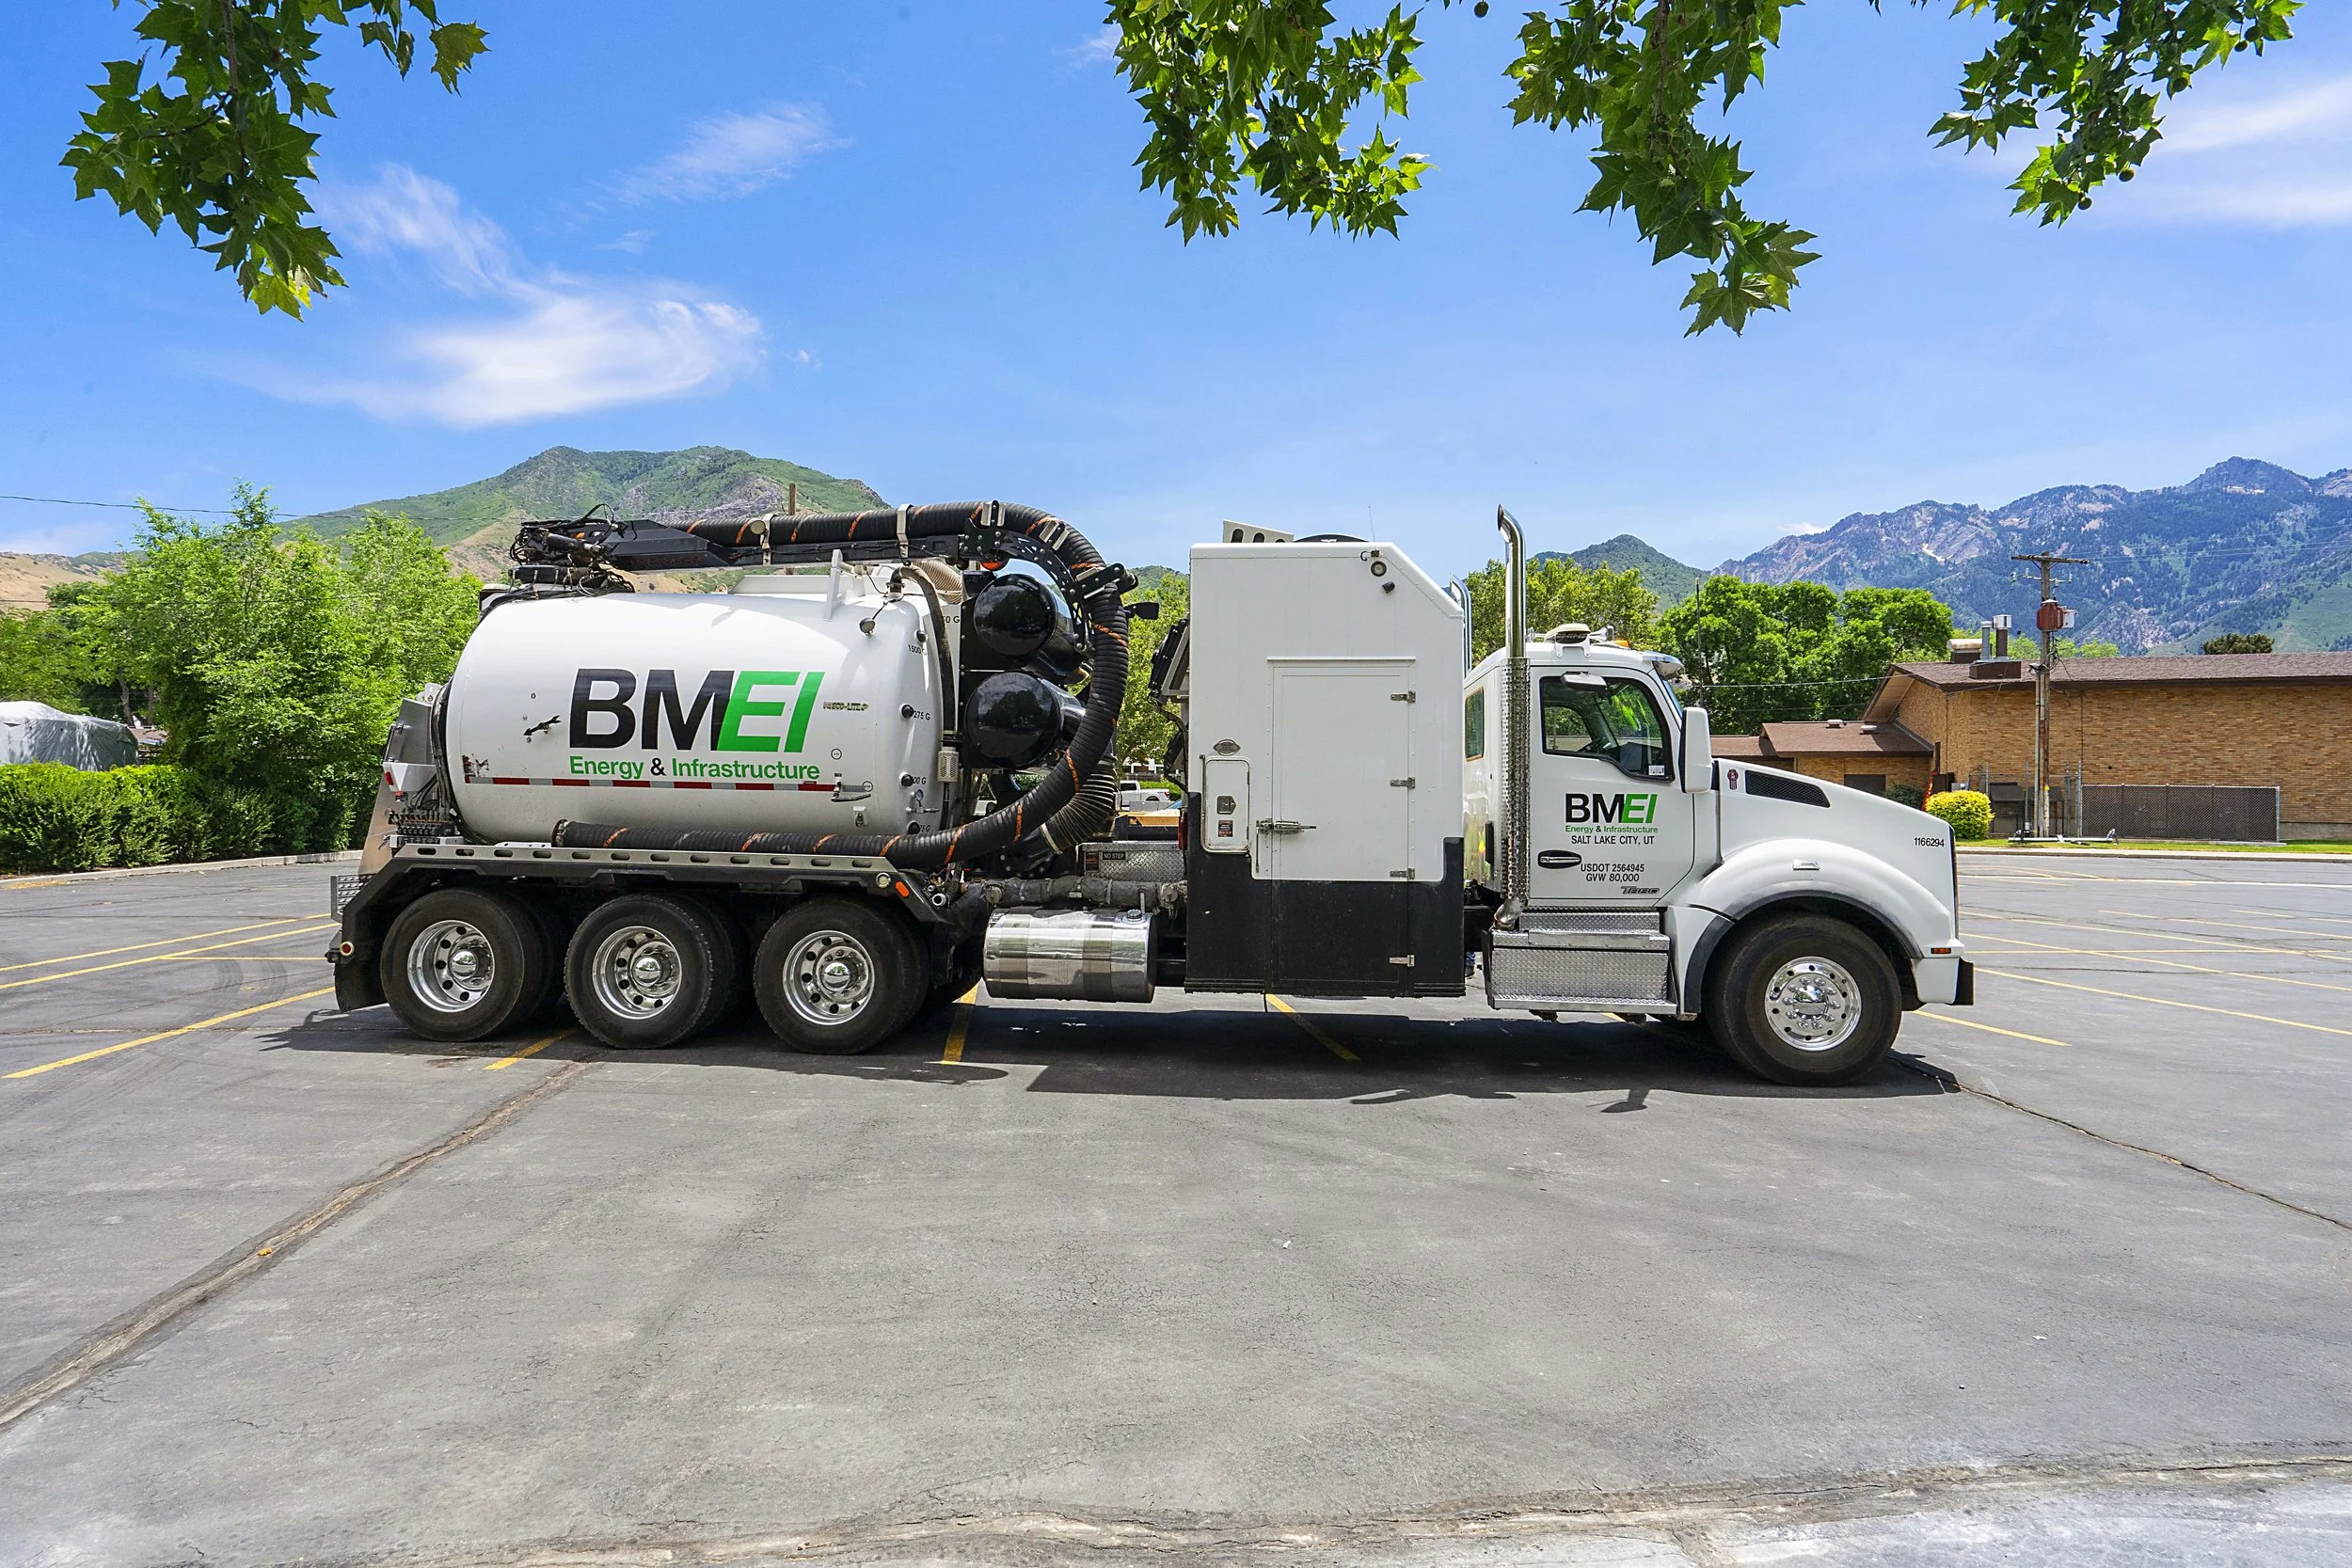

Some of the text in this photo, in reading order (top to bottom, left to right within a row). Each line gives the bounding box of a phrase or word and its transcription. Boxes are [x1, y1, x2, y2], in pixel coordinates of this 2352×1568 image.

[908, 644, 921, 654] 1500
[569, 668, 825, 752] BMEI
[569, 755, 820, 779] Energy & Infrastructure
[1565, 793, 1658, 823] BMEI
[1565, 825, 1594, 833] Energy
[1571, 835, 1655, 846] SALT LAKE CITY, UT
[1914, 837, 1945, 847] 1166294
[1581, 863, 1645, 873] USDOT 2564945
[1586, 873, 1640, 883] GVW 80,000
